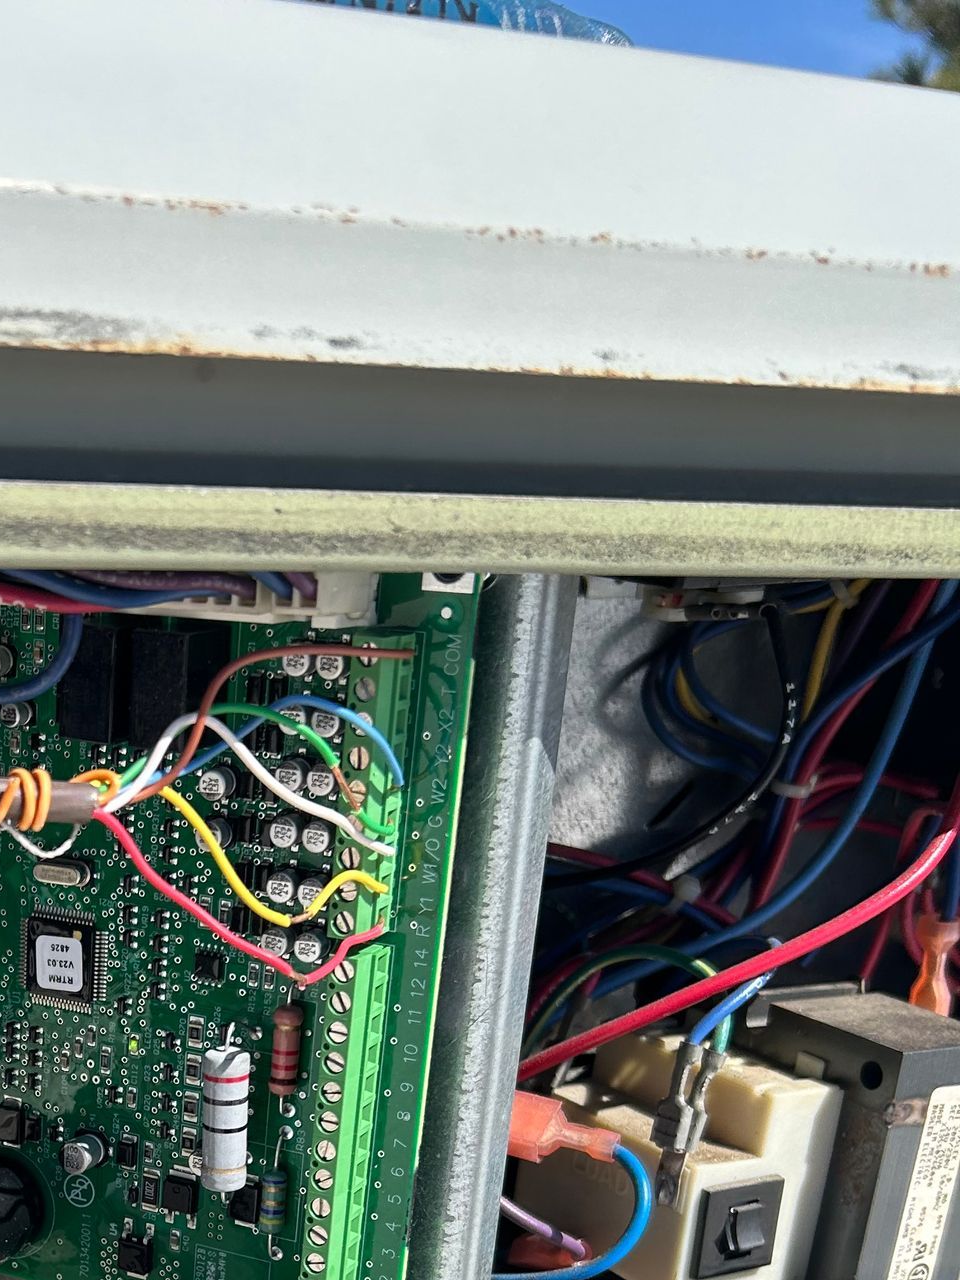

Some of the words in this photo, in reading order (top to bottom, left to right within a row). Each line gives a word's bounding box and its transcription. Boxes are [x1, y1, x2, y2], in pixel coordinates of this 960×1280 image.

[443, 634, 465, 677] COM
[441, 681, 457, 698] T
[438, 708, 456, 735] X2
[434, 743, 451, 768] Y2
[430, 776, 448, 805] W2
[427, 814, 443, 829] G
[417, 897, 434, 916] Y1
[415, 925, 431, 939] R
[47, 959, 75, 970] V23.03
[413, 948, 430, 969] 14
[48, 974, 74, 985] RTRM
[410, 978, 427, 998] 12
[264, 993, 272, 1016] R153
[407, 1008, 423, 1026] 11
[178, 1018, 186, 1036] R70
[403, 1042, 420, 1065] 10
[399, 1081, 415, 1093] 9
[396, 1109, 412, 1122] 8
[296, 1130, 305, 1151] R83
[393, 1138, 408, 1151] 7
[390, 1166, 405, 1179] 6
[387, 1193, 402, 1206] 5
[109, 1222, 118, 1236] U4
[385, 1219, 401, 1233] 4
[381, 1247, 397, 1260] 3
